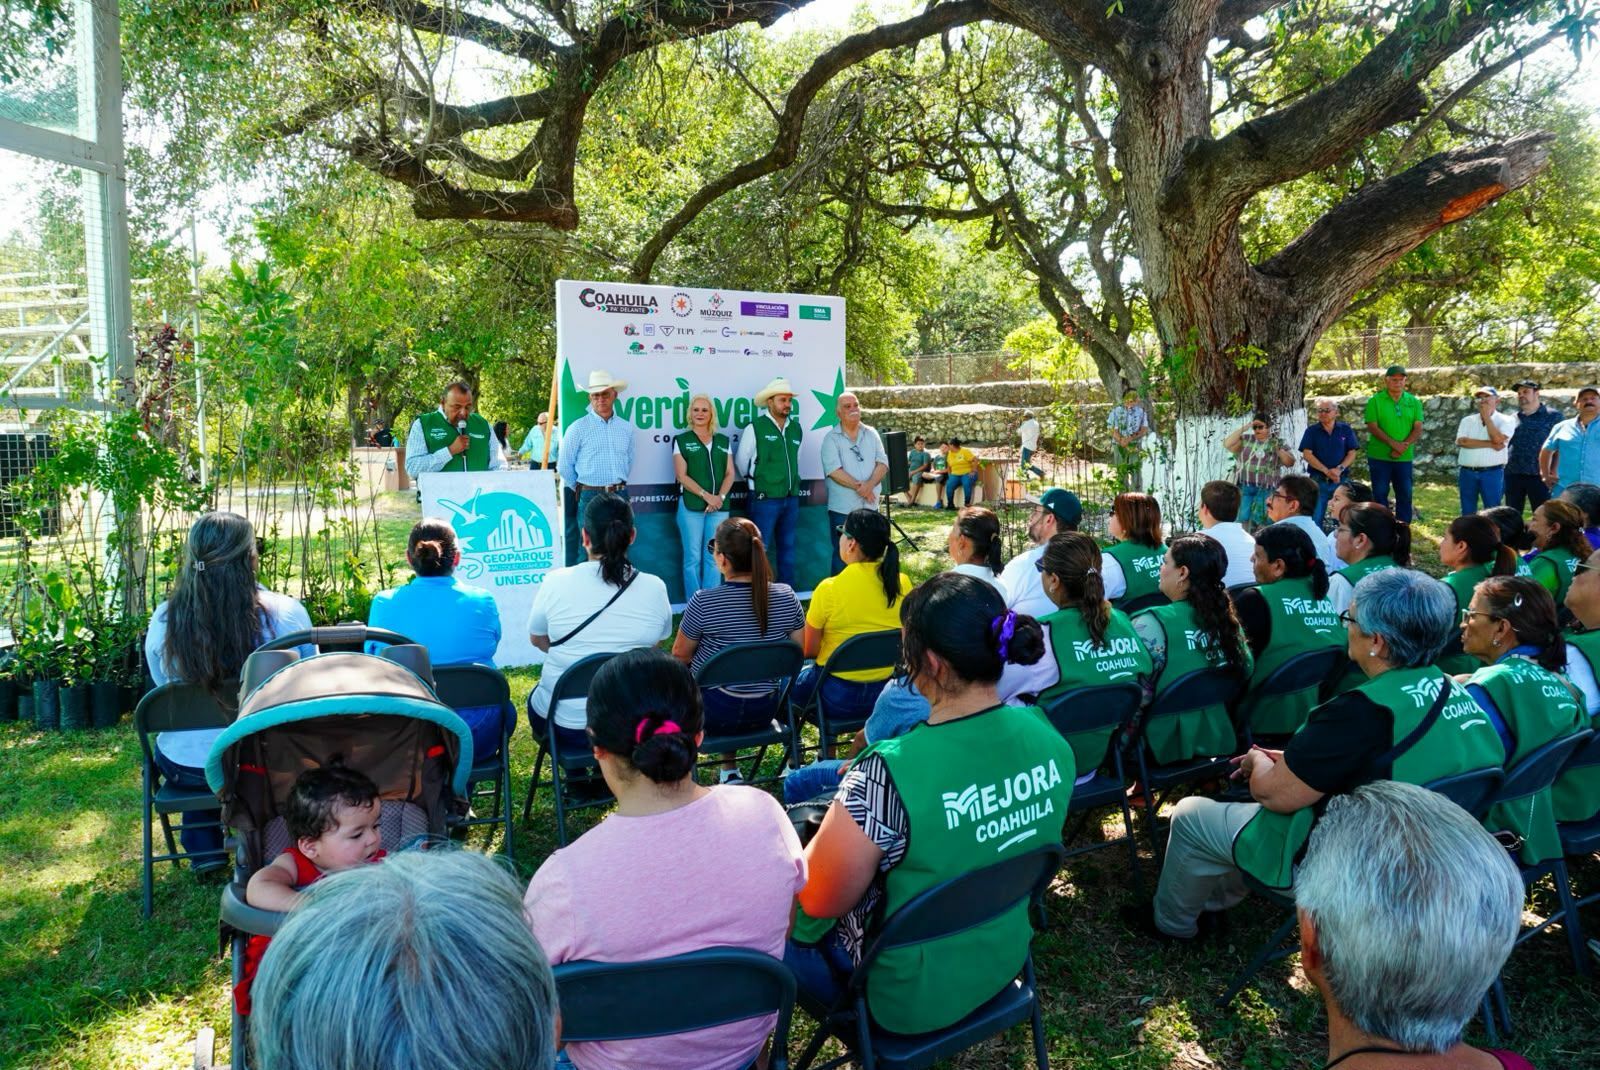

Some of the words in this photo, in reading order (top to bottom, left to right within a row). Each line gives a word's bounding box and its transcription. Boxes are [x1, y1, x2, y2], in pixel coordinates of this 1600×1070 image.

[579, 288, 658, 307] COAHUILA
[700, 308, 733, 318] MÚZQUIZ
[614, 391, 690, 430] verd
[483, 551, 554, 564] GEOPARQUE
[1304, 617, 1338, 626] COAHUILA
[1072, 637, 1141, 662] MEJORA
[1096, 657, 1139, 672] COAHUILA
[941, 758, 1062, 830] MEJORA
[975, 798, 1054, 843] COAHUILA
